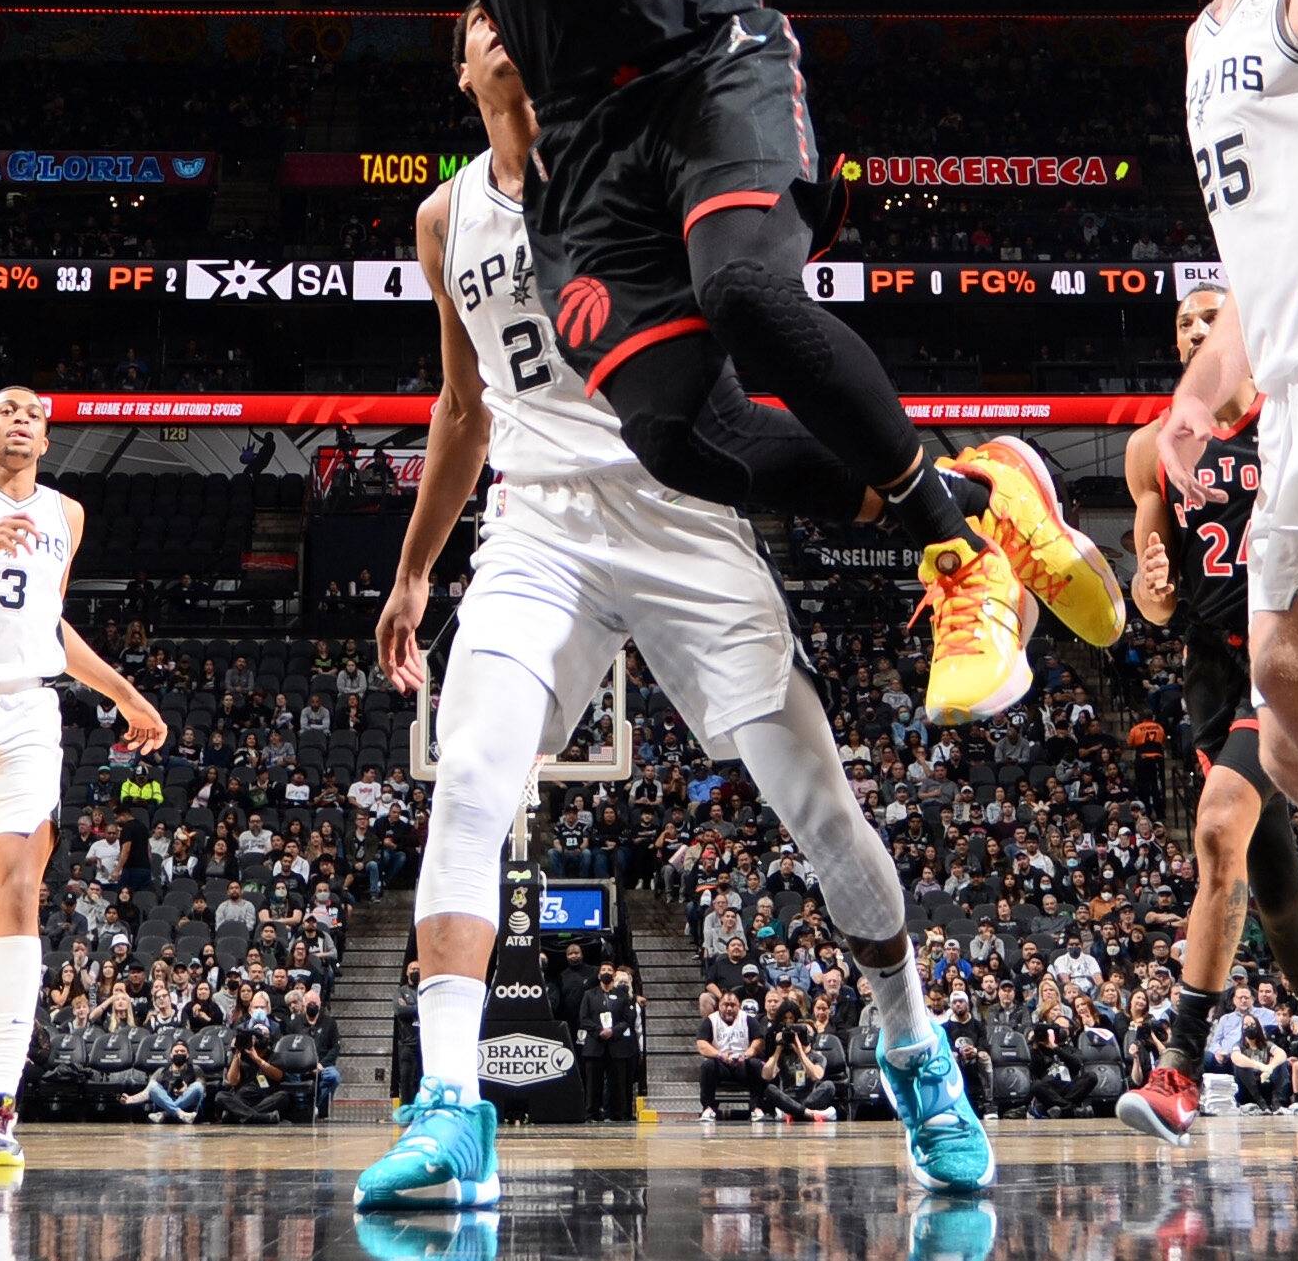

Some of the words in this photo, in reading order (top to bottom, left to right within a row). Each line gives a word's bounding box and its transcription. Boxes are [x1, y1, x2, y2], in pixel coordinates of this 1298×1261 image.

[360, 154, 428, 184] TACOS
[867, 157, 1107, 185] BURGERTECA
[56, 267, 91, 291] 33.3
[110, 267, 152, 289] PF
[165, 268, 176, 291] 2
[297, 265, 347, 296] SA
[383, 266, 402, 297] 4
[458, 245, 535, 312] SPU
[816, 267, 834, 298] 8
[871, 270, 915, 293] PF
[931, 270, 942, 295] 0
[961, 270, 1036, 294] FG%
[1051, 270, 1086, 295] 40.0
[1100, 270, 1146, 293] TO
[1155, 271, 1165, 294] 7
[1185, 267, 1219, 280] BLK
[502, 320, 554, 392] 2
[77, 402, 94, 415] THE
[135, 402, 151, 415] THE
[152, 402, 170, 415] SAN
[171, 402, 211, 415] ANTONIO
[212, 402, 242, 415] SPURS
[163, 427, 186, 440] 128
[0, 568, 27, 609] 3
[506, 936, 533, 947] AT&T
[495, 982, 542, 999] odoo
[487, 1045, 548, 1059] BRAKE
[487, 1061, 548, 1075] CHECK
